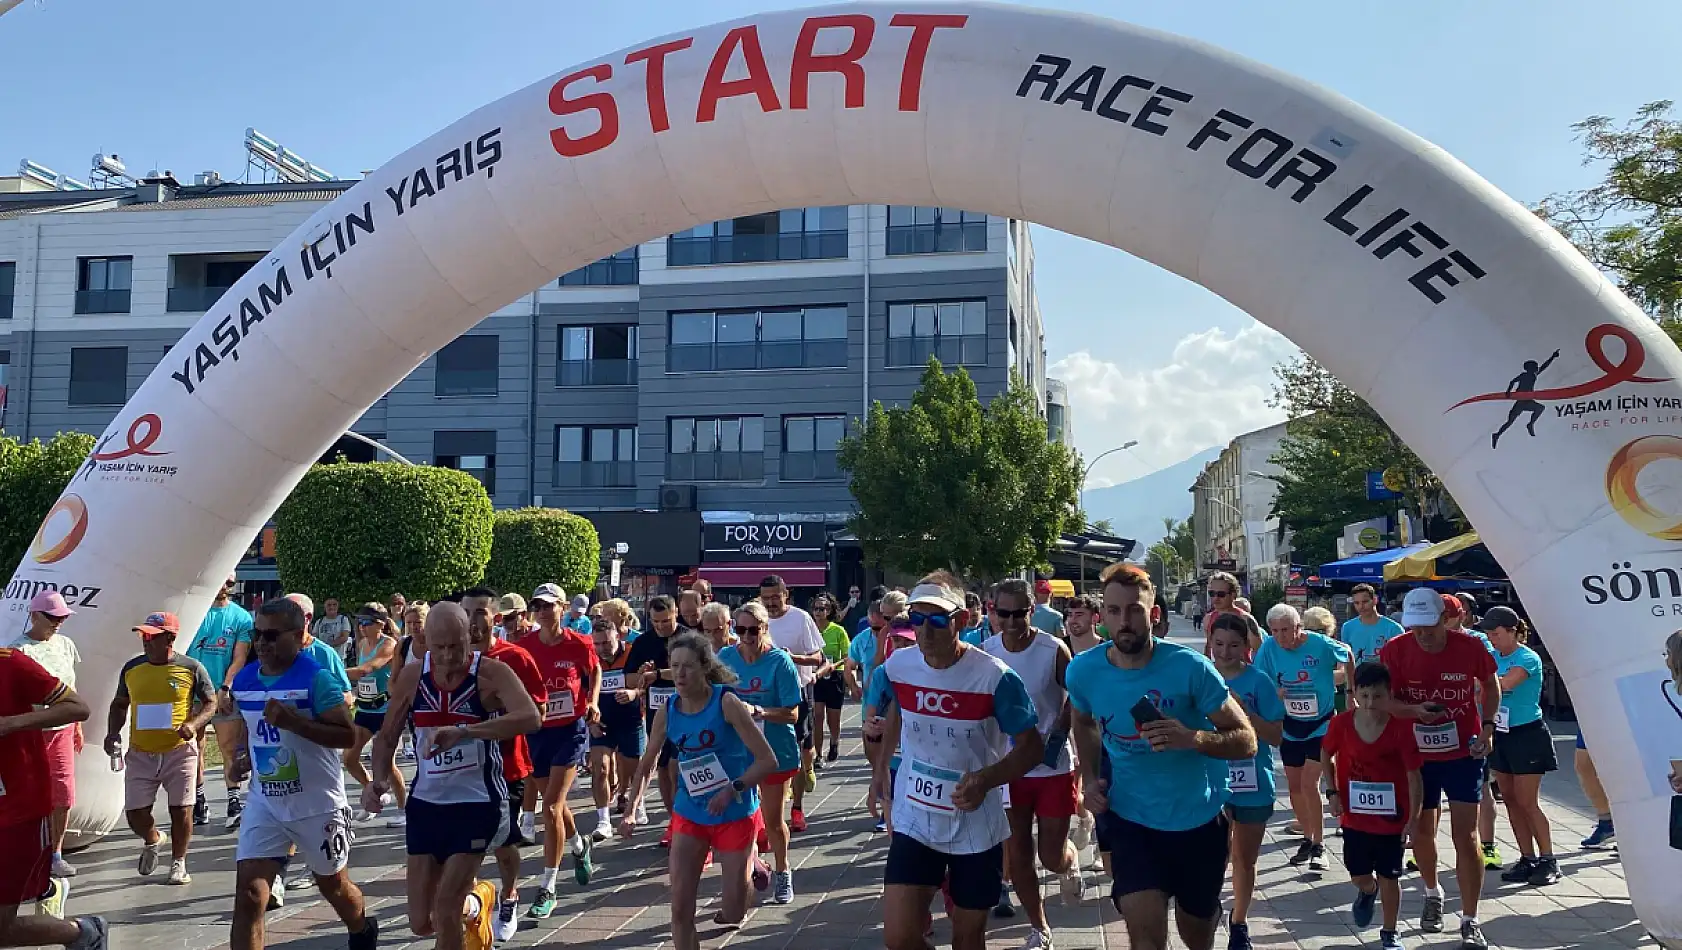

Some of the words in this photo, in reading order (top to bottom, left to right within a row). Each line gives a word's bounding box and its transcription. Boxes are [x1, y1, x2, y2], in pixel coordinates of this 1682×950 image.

[548, 14, 969, 157] START
[1015, 54, 1193, 136] RACE
[1186, 108, 1337, 203] FOR
[1323, 184, 1487, 304] LIFE
[171, 265, 293, 394] YAŞAM
[385, 127, 502, 216] YARIŞ
[1555, 399, 1612, 418] YAŞAM
[1617, 395, 1648, 413] İÇİN
[1571, 419, 1611, 431] RACE
[1621, 416, 1648, 424] FOR
[1657, 415, 1682, 423] LIF
[724, 525, 759, 542] FOR
[764, 524, 802, 542] YOU
[741, 543, 784, 559] Boutique
[1581, 561, 1682, 605] sön
[1423, 734, 1449, 745] 085
[690, 768, 714, 785] 066
[915, 777, 943, 800] 061
[1359, 793, 1384, 806] 081
